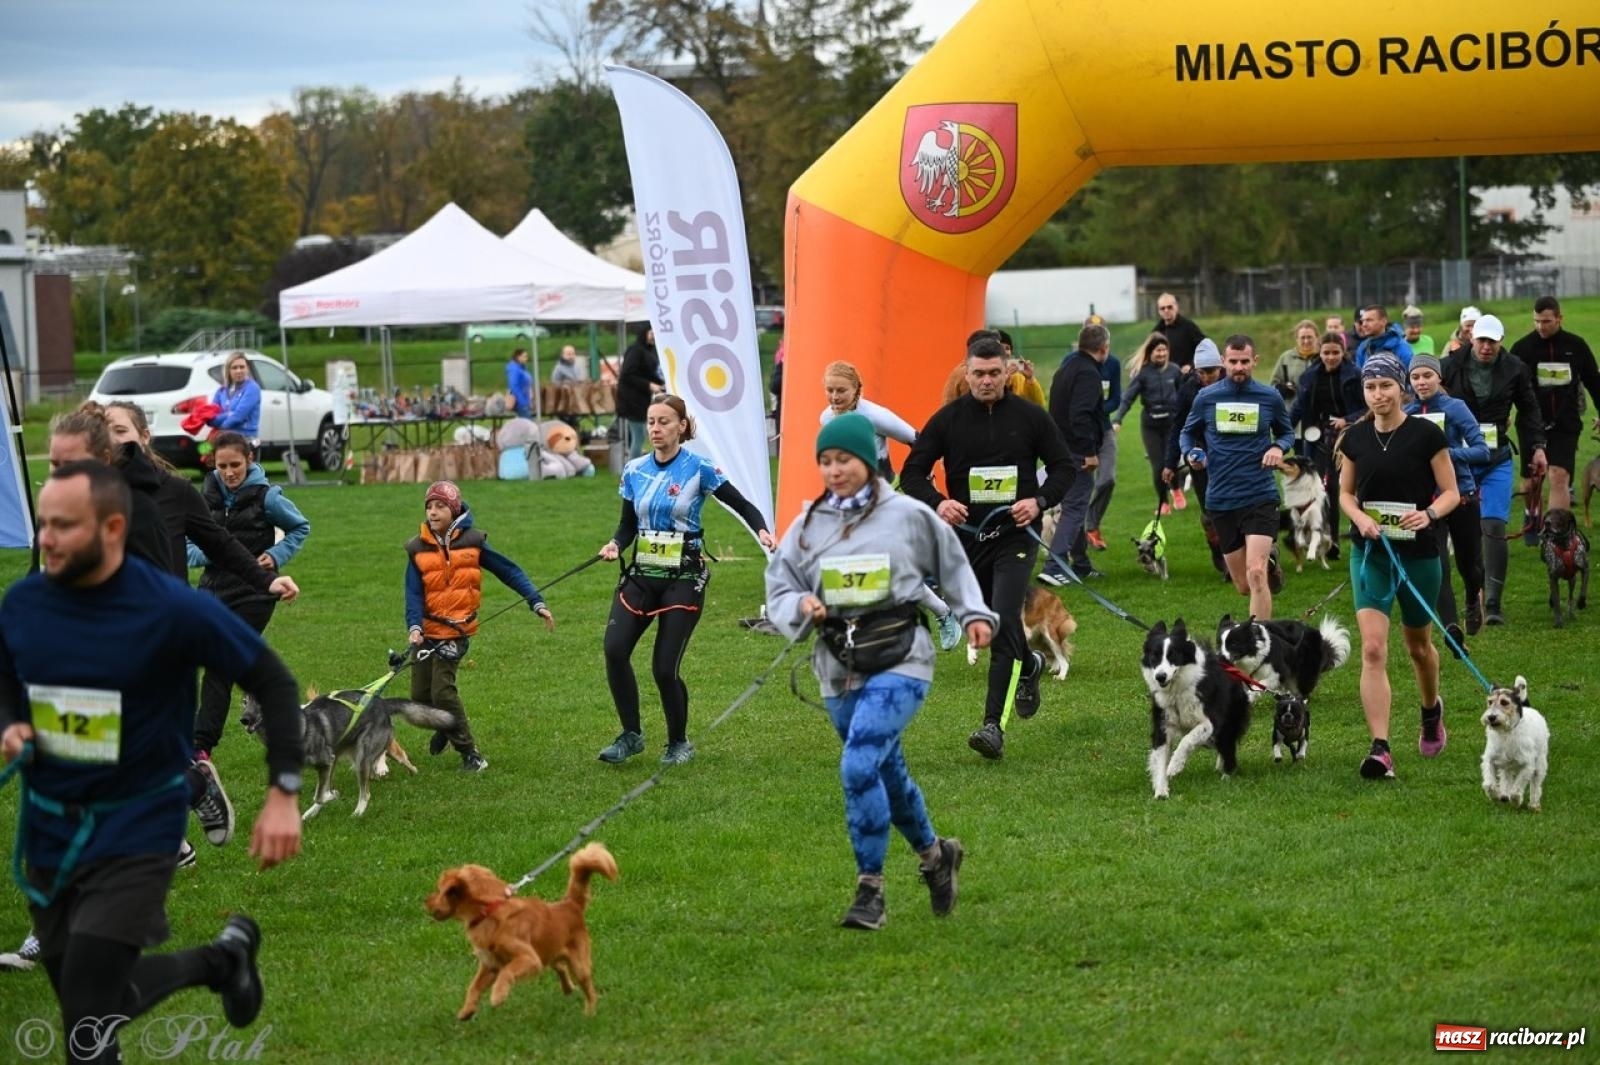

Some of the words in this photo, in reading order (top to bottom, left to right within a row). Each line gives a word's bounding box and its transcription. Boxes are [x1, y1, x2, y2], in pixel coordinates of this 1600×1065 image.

[1175, 39, 1361, 82] MIASTO
[1229, 412, 1246, 422] 26
[984, 479, 1003, 491] 27
[1380, 514, 1400, 526] 20
[649, 543, 666, 555] 31
[842, 572, 867, 588] 37
[58, 713, 89, 736] 12
